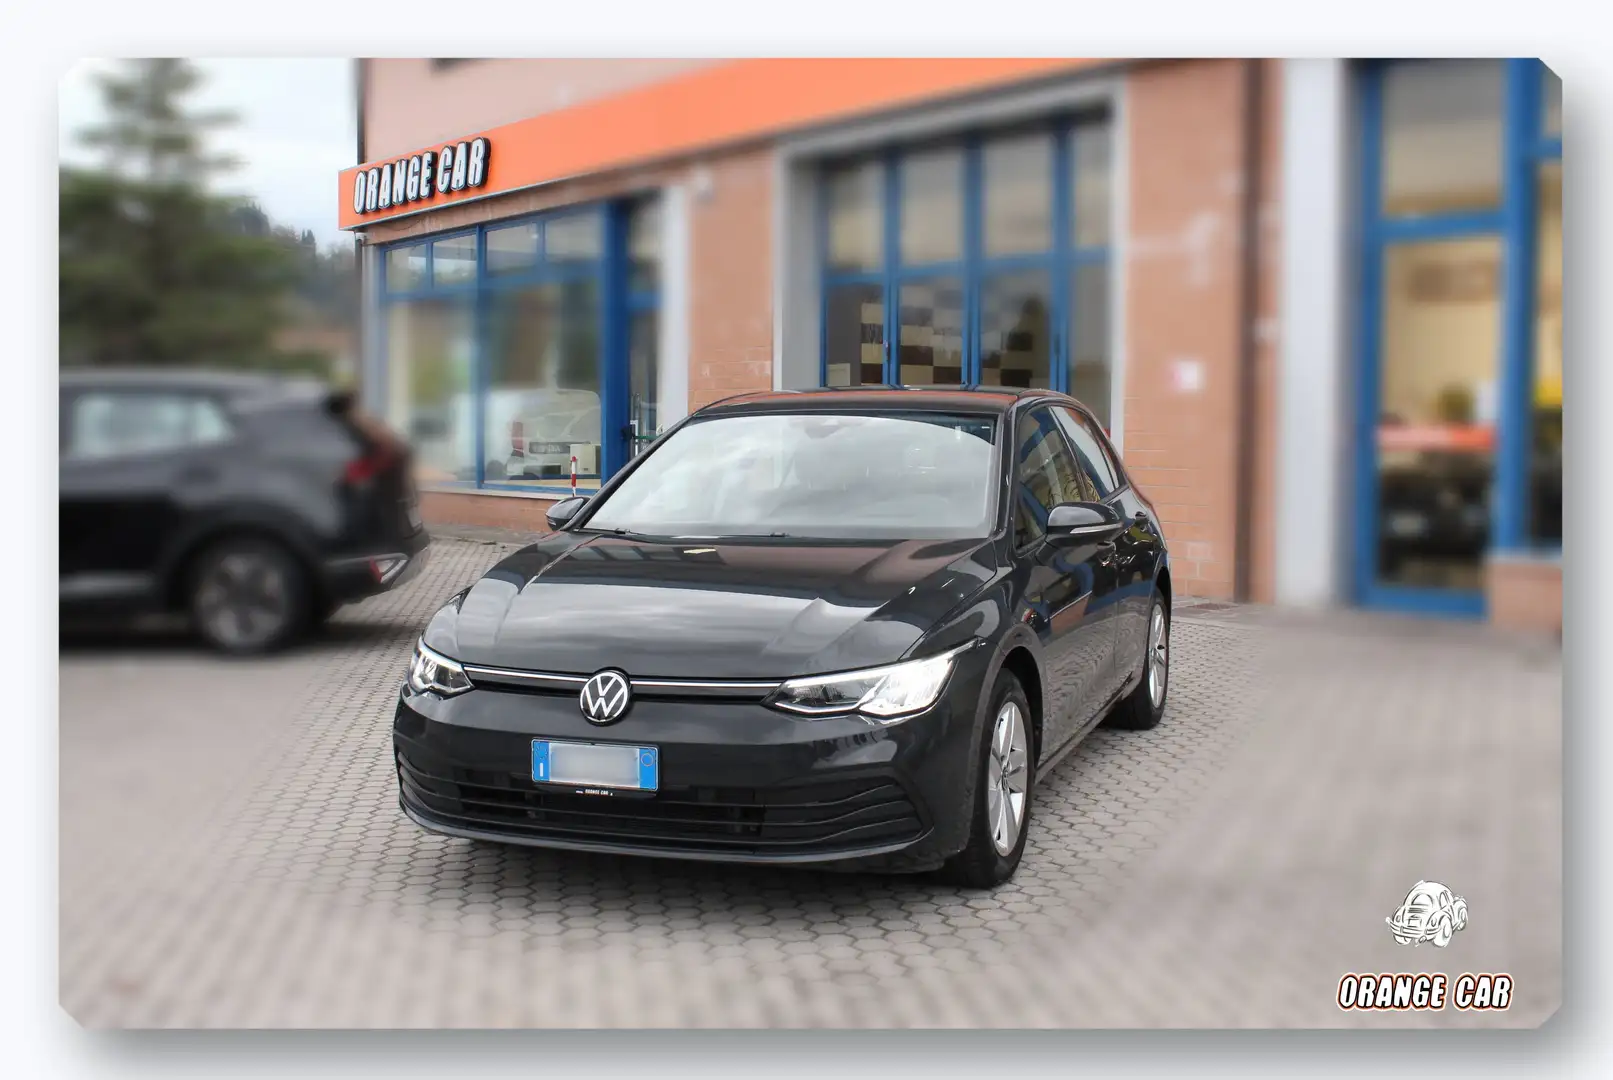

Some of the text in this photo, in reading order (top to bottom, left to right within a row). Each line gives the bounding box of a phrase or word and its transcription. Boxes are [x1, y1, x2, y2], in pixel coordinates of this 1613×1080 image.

[353, 137, 491, 214] ORANGE CAR
[582, 673, 627, 719] VW
